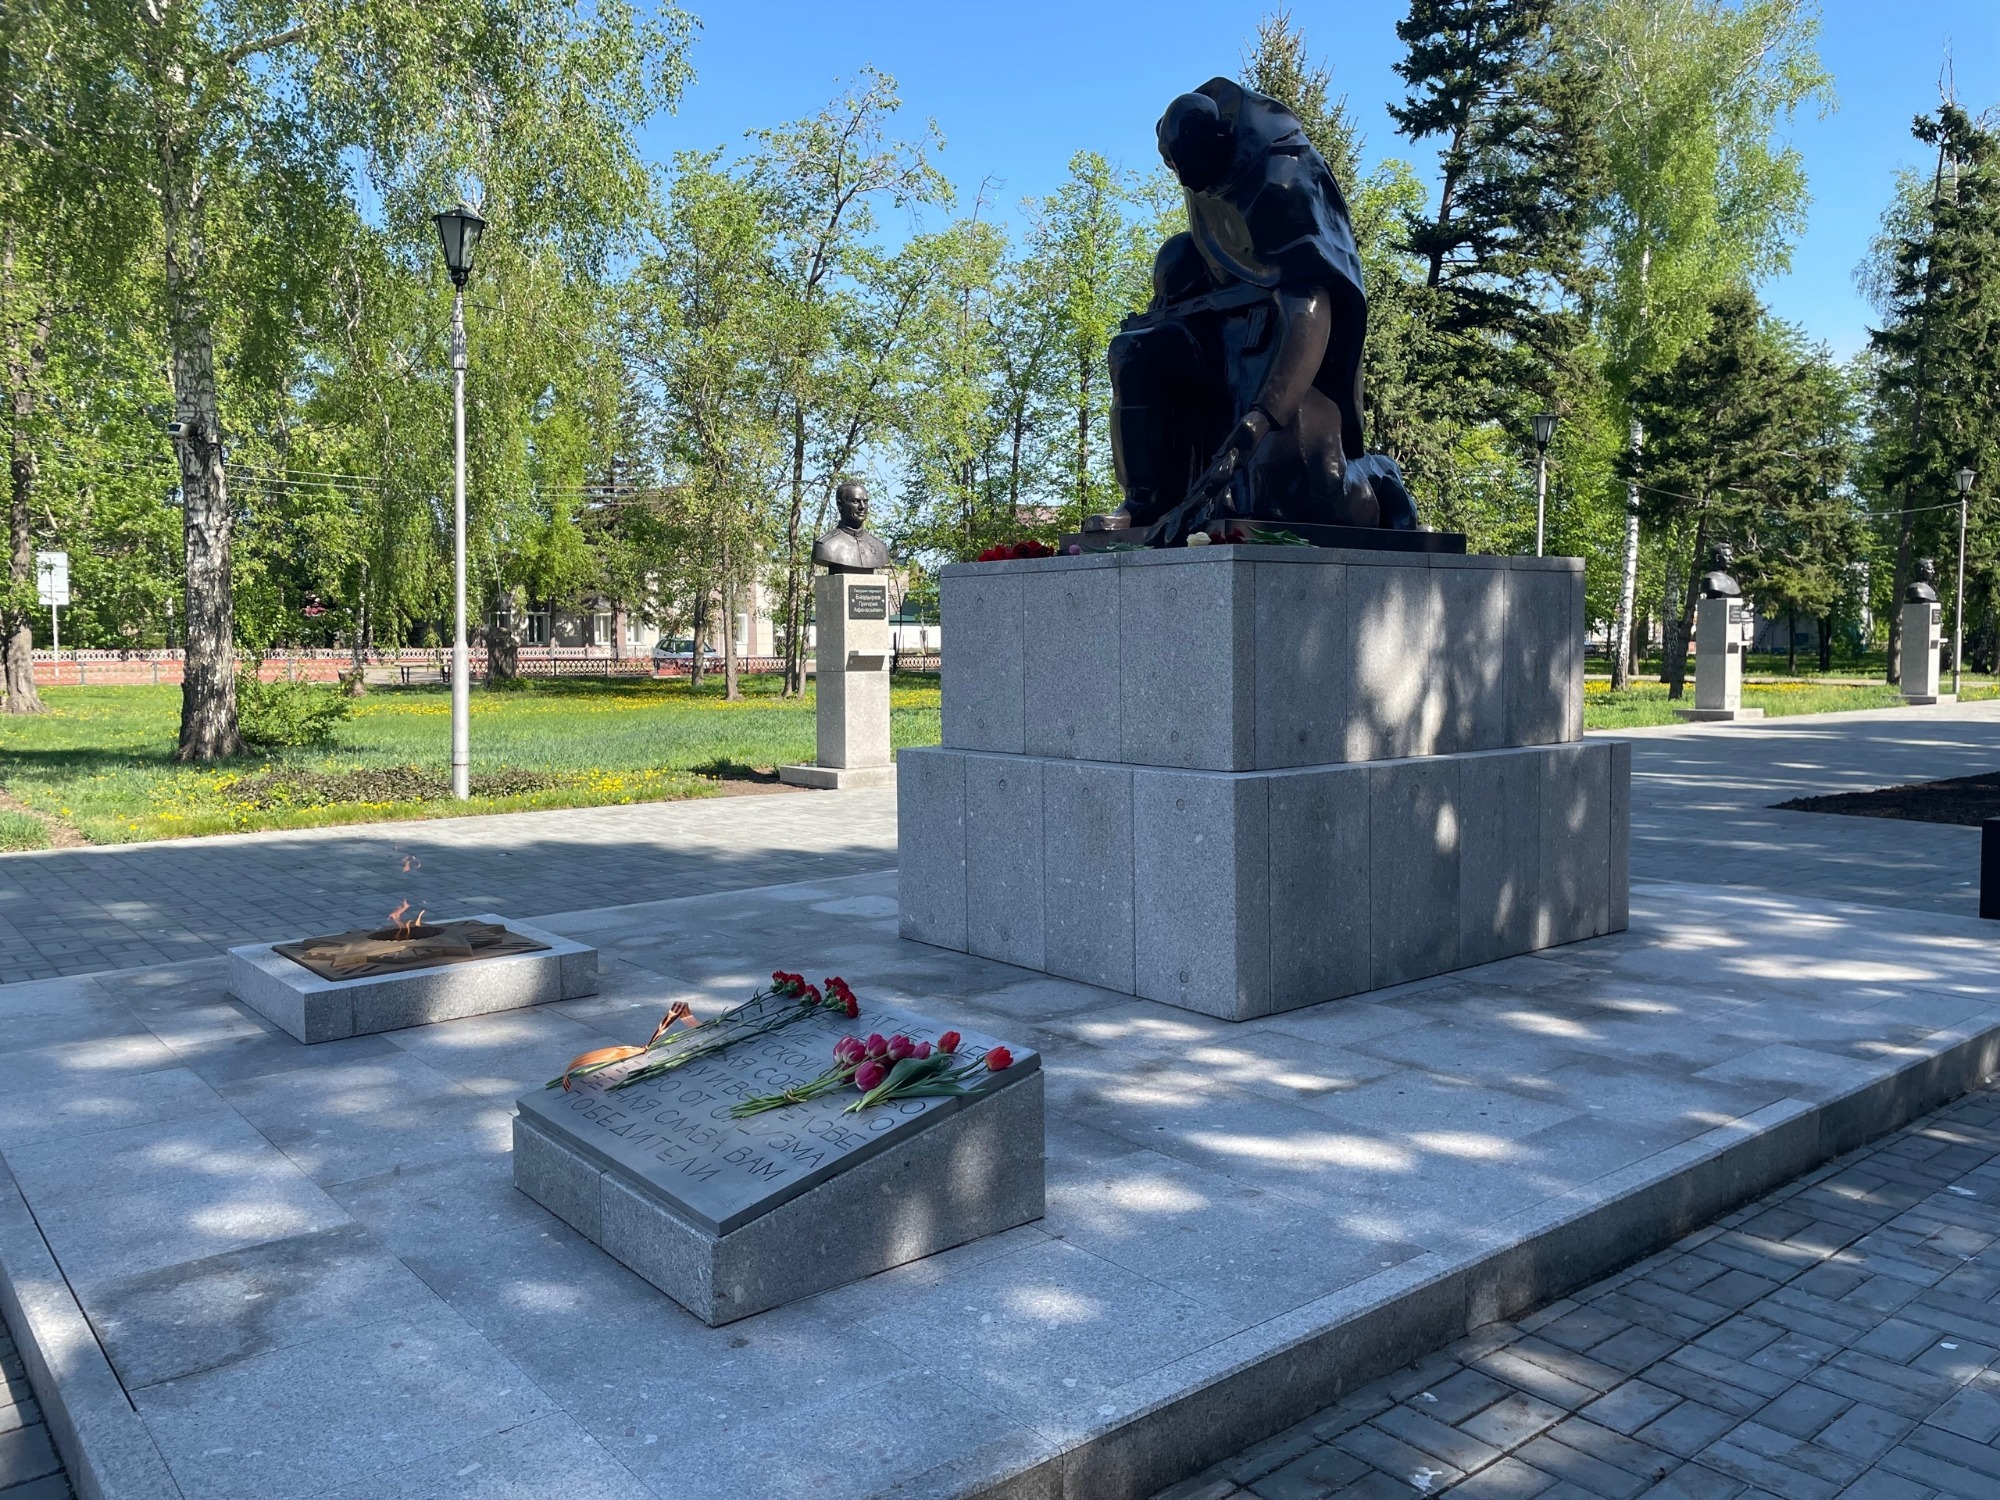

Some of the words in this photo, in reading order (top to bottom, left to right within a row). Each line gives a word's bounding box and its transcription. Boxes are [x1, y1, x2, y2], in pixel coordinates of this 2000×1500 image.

[672, 1087, 718, 1110] ОТ
[702, 1072, 735, 1088] И
[748, 1065, 900, 1133] СОВТСЮ
[553, 1087, 724, 1185] ПОБЕДИТЕЛИ
[577, 1070, 663, 1115] ВЕНАЯ
[648, 1107, 736, 1154] СЛАВА
[719, 1144, 791, 1183] ВАМ
